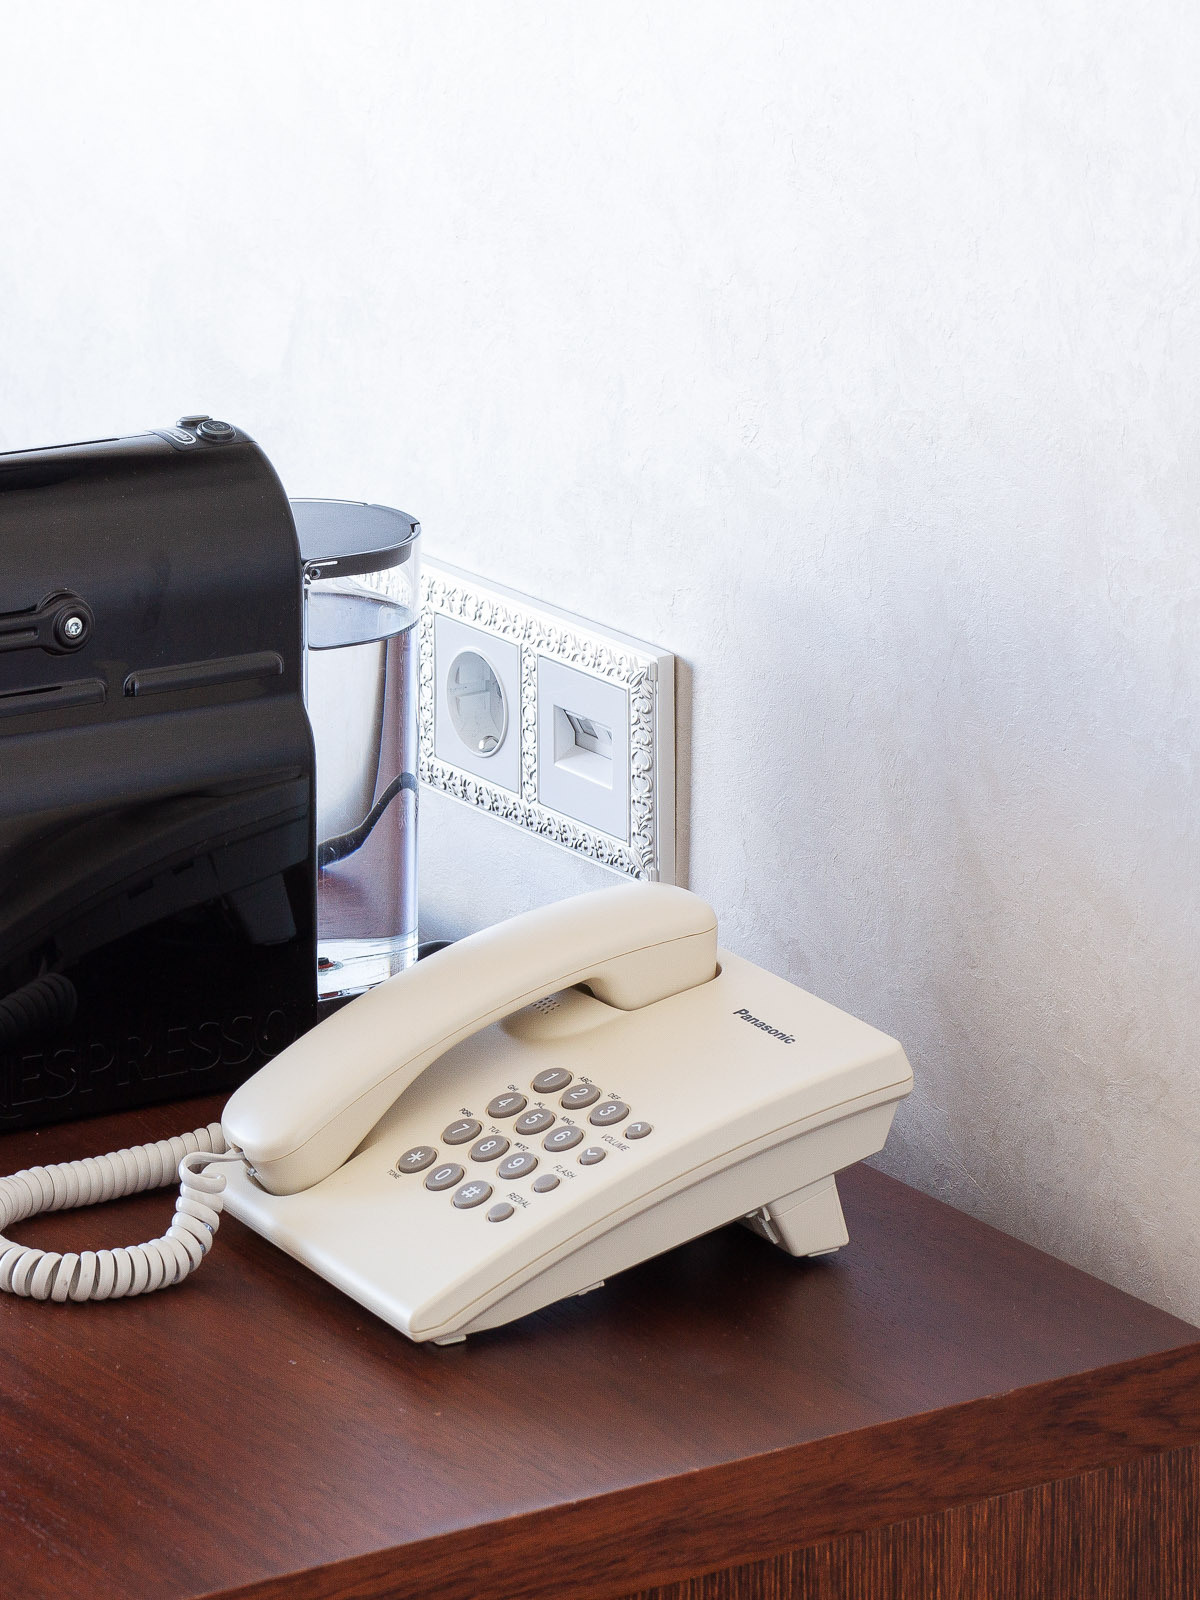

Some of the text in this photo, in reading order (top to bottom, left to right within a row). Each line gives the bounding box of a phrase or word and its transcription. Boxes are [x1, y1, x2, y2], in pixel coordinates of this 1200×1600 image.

[732, 1008, 795, 1044] Panasonic
[544, 1072, 560, 1082] 1
[578, 1076, 592, 1085] ABC
[570, 1088, 588, 1099] 2
[607, 1092, 621, 1100] DEF
[498, 1097, 514, 1108] 4
[600, 1105, 617, 1116] 3
[525, 1113, 543, 1124] 5
[560, 1116, 575, 1125] MNO
[451, 1123, 470, 1134] 7
[488, 1125, 502, 1135] TUV
[554, 1130, 572, 1141] 6
[480, 1140, 497, 1152] 8
[601, 1133, 630, 1152] VOLUME
[507, 1157, 525, 1169] 9
[386, 1169, 402, 1180] TONE
[553, 1164, 579, 1179] FLASH
[506, 1192, 532, 1209] REDIAL
